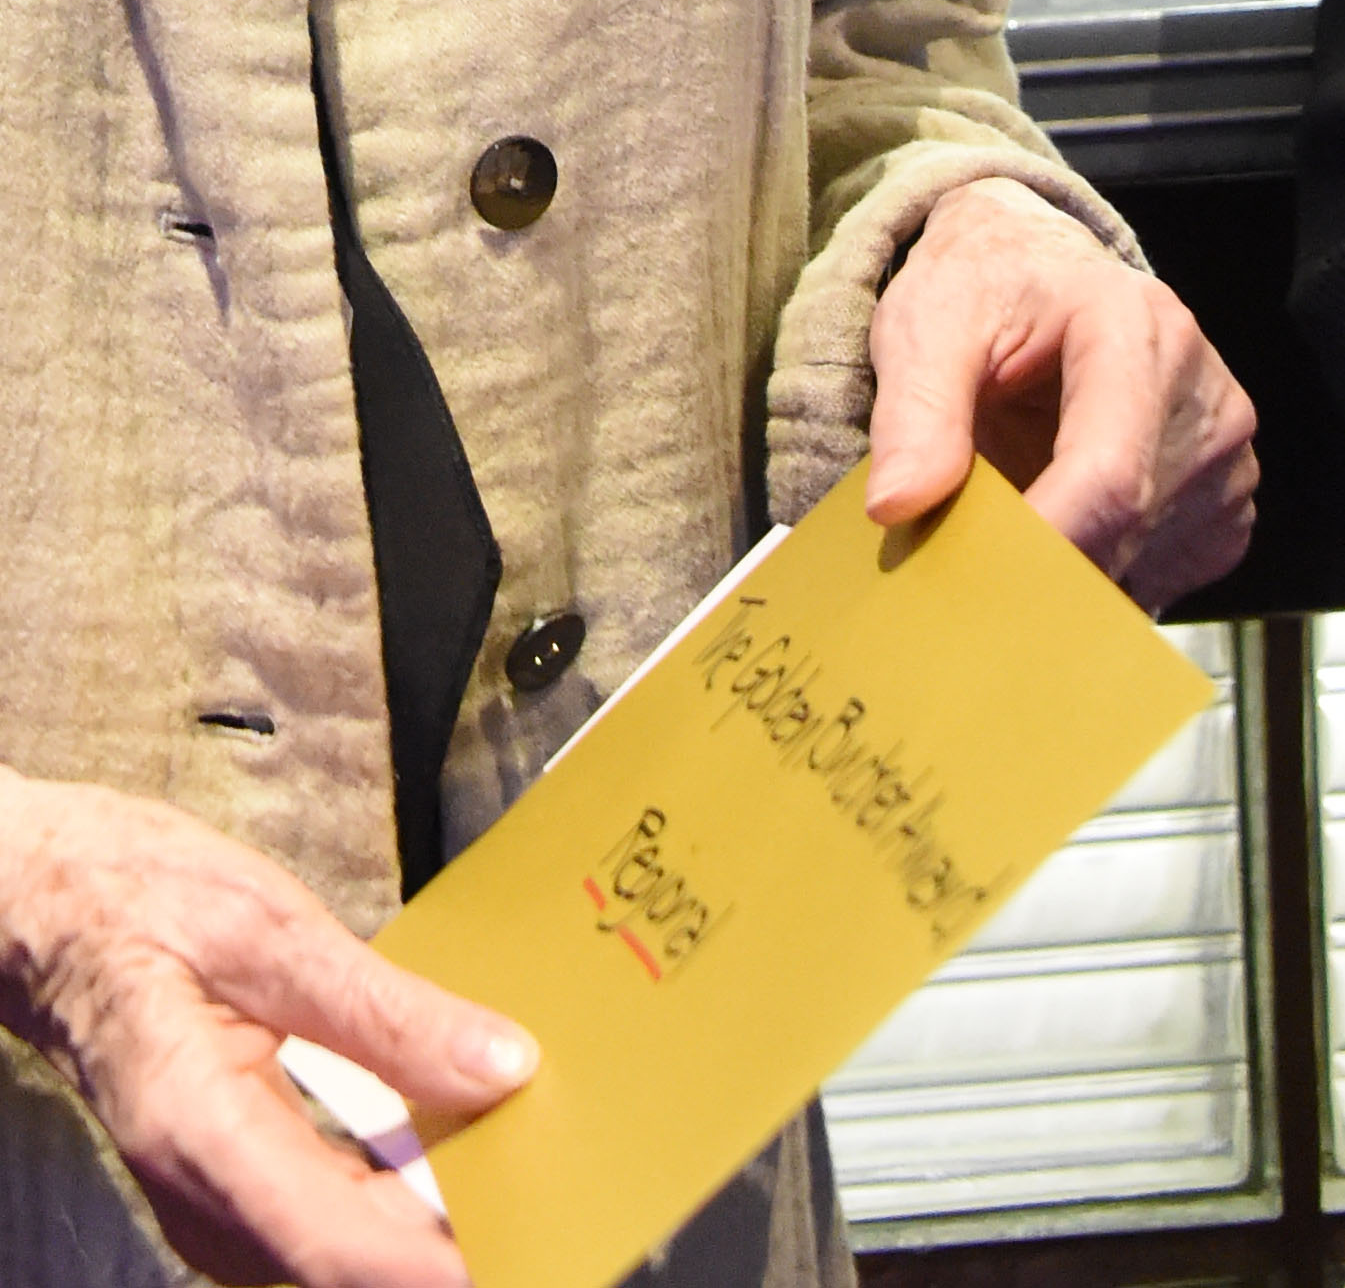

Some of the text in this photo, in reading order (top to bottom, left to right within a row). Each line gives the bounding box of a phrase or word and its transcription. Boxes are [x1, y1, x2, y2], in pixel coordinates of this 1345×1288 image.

[692, 596, 767, 691] The
[709, 634, 824, 768] Golden
[596, 805, 736, 985] Regional
